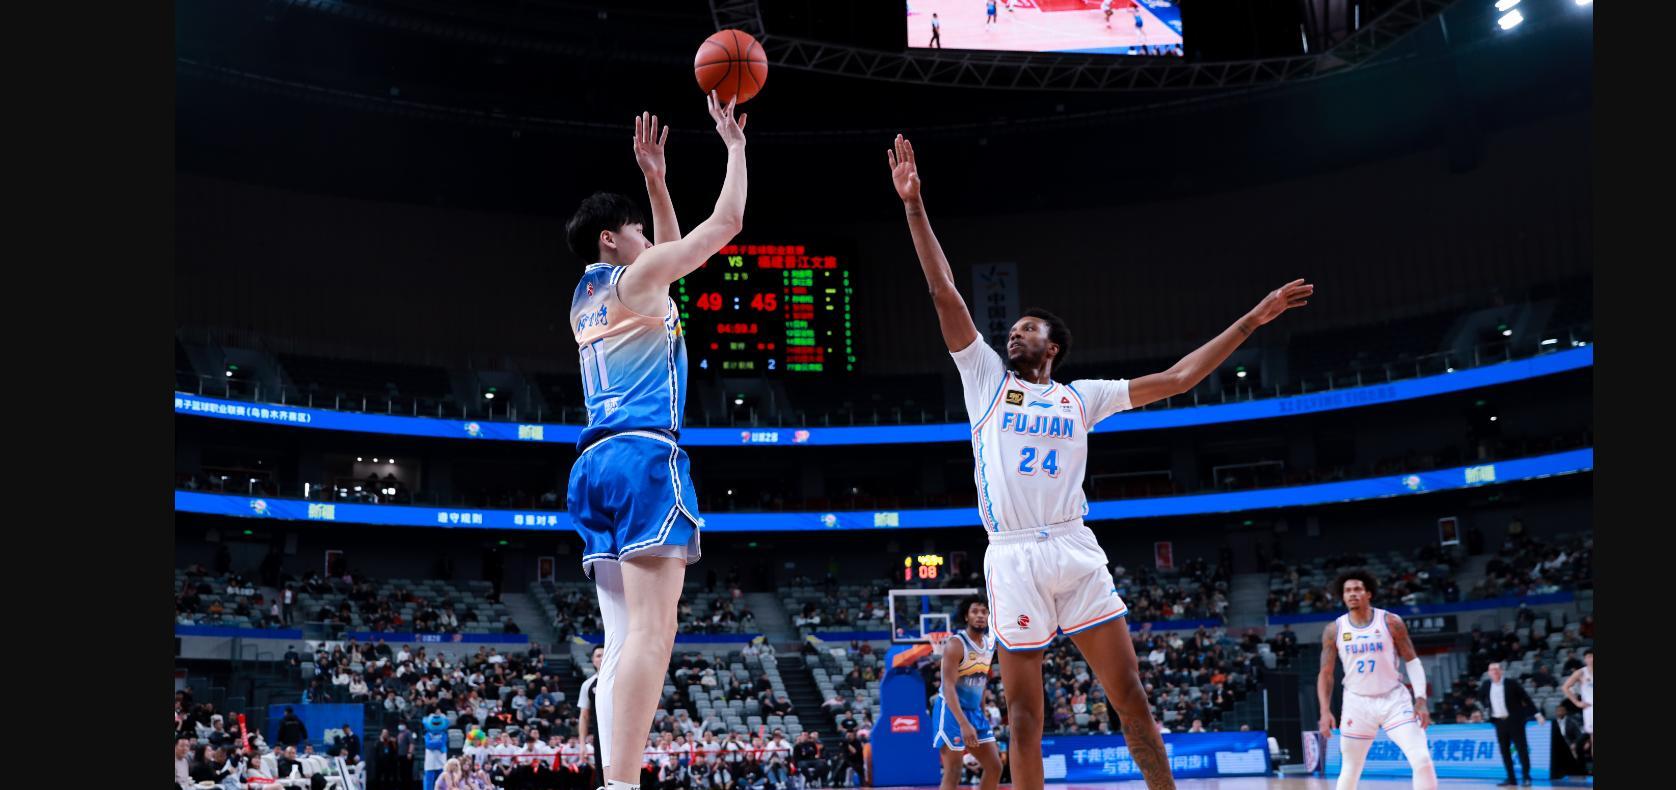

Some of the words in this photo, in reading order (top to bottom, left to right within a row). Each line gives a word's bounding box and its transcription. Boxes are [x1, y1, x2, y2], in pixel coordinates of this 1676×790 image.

[728, 256, 743, 267] VS
[697, 292, 723, 311] 49
[750, 292, 777, 311] 45
[700, 359, 708, 369] 4
[768, 359, 776, 370] 2
[1001, 411, 1076, 440] FUJIAN
[1018, 446, 1061, 479] 24
[918, 565, 937, 579] 08
[1345, 642, 1384, 655] FUJIAN
[1356, 659, 1376, 674] 27
